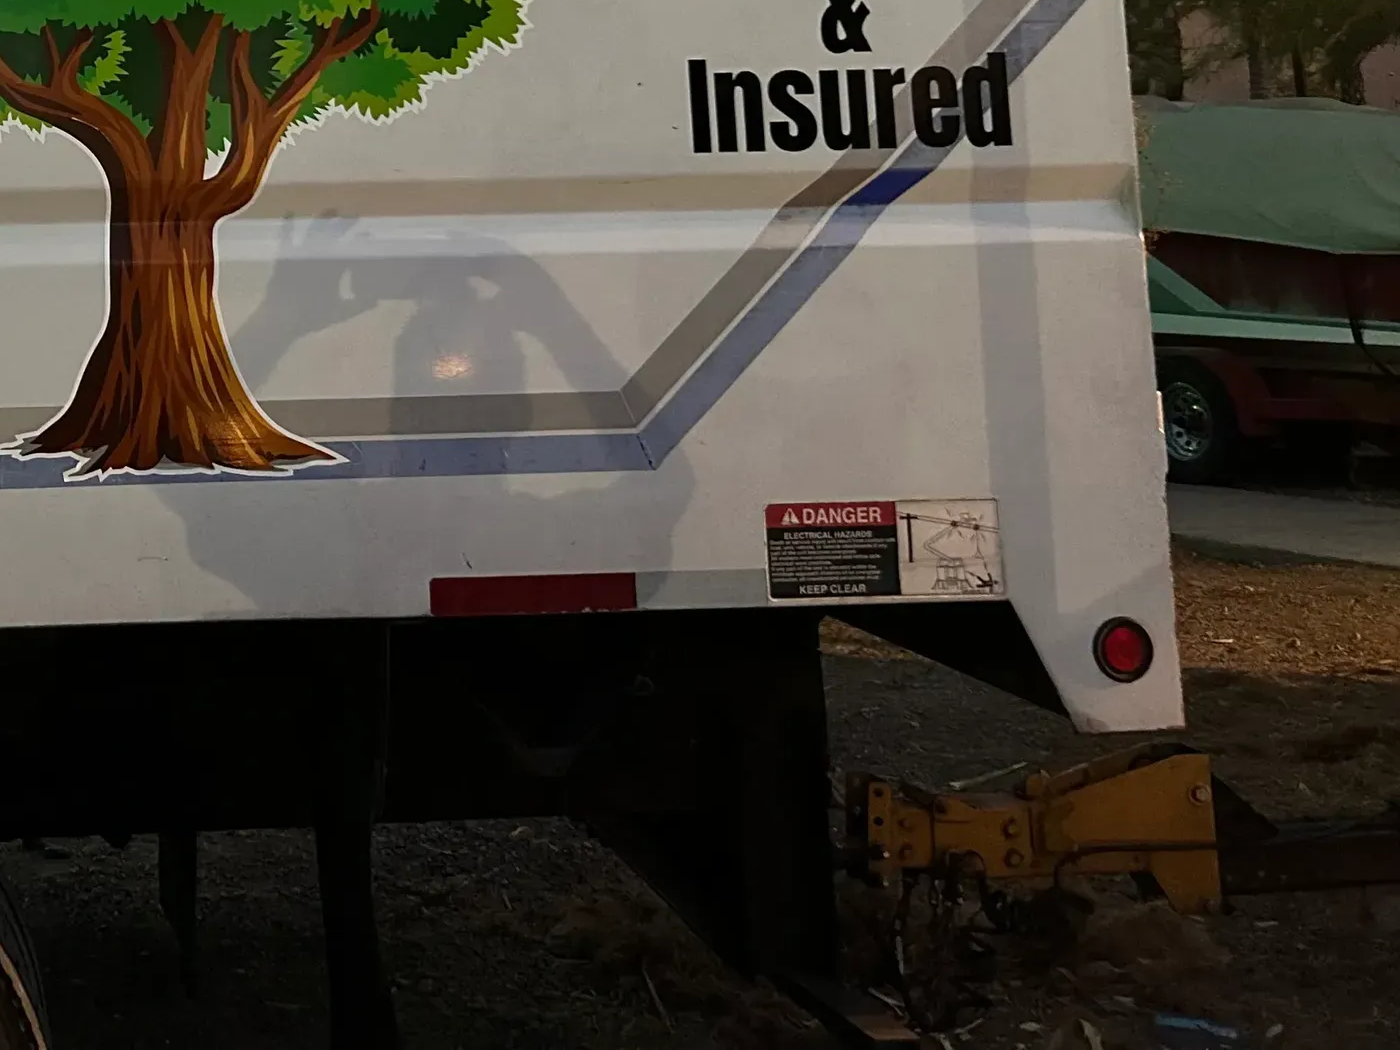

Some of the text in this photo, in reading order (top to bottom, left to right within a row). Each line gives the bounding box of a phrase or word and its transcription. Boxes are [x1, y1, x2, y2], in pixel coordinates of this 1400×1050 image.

[689, 52, 1012, 154] Insured
[802, 506, 881, 524] DANGER
[783, 530, 873, 540] ELECTRICAL HAZARDS
[799, 583, 867, 595] KEEP CLEAR
